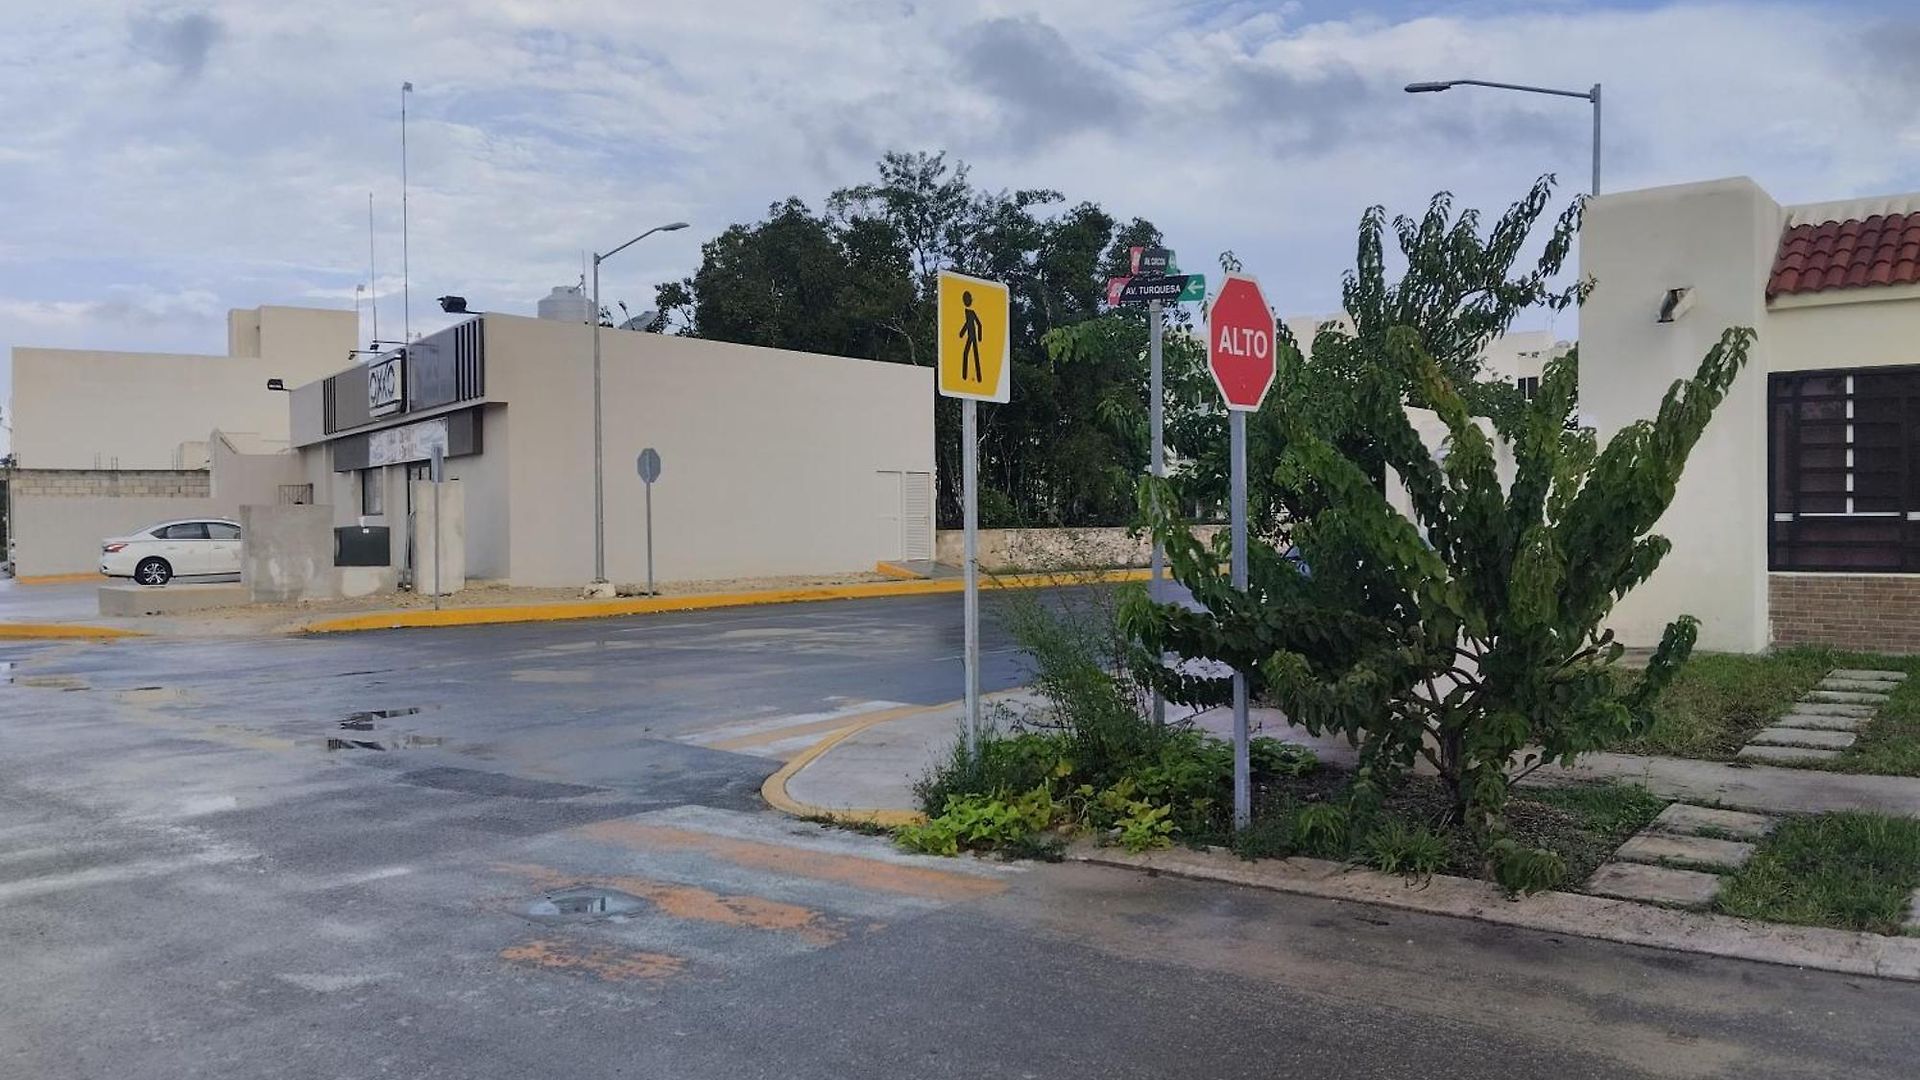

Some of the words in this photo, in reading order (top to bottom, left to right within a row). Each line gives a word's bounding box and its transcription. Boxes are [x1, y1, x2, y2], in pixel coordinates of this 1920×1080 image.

[1125, 287, 1137, 296] AV.
[1139, 285, 1181, 296] TURQUESA
[1218, 326, 1268, 359] ALTO
